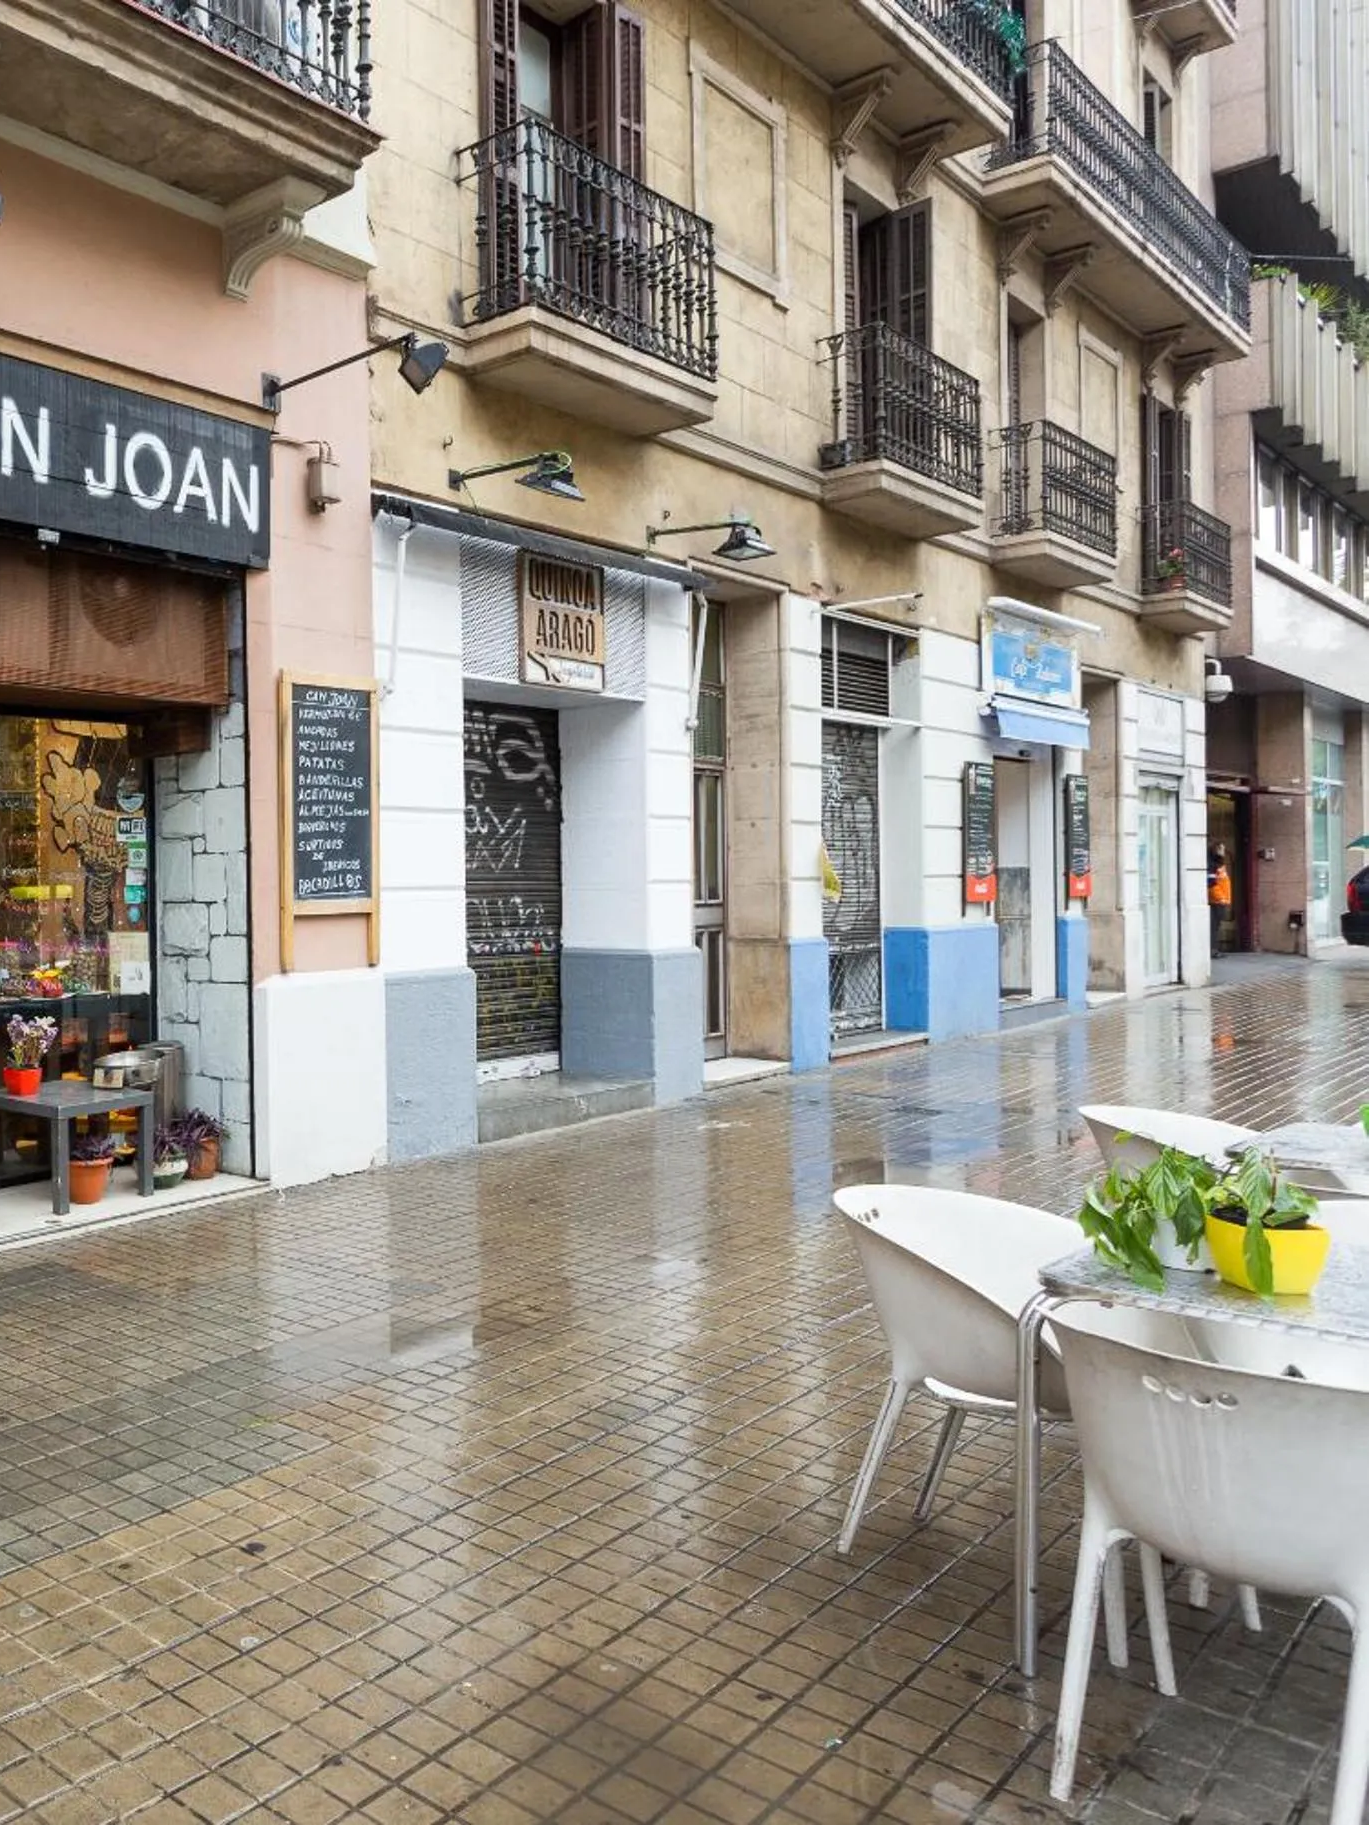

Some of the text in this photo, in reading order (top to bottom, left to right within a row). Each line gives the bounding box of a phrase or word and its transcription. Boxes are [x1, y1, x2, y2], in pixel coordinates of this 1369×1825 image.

[84, 422, 260, 535] JOAN
[536, 609, 596, 656] ARAGÓ
[306, 691, 327, 702] CAN
[298, 755, 345, 770] PATATAS
[297, 788, 355, 802] ACEITUNAS
[298, 804, 344, 818] ALMEJAS
